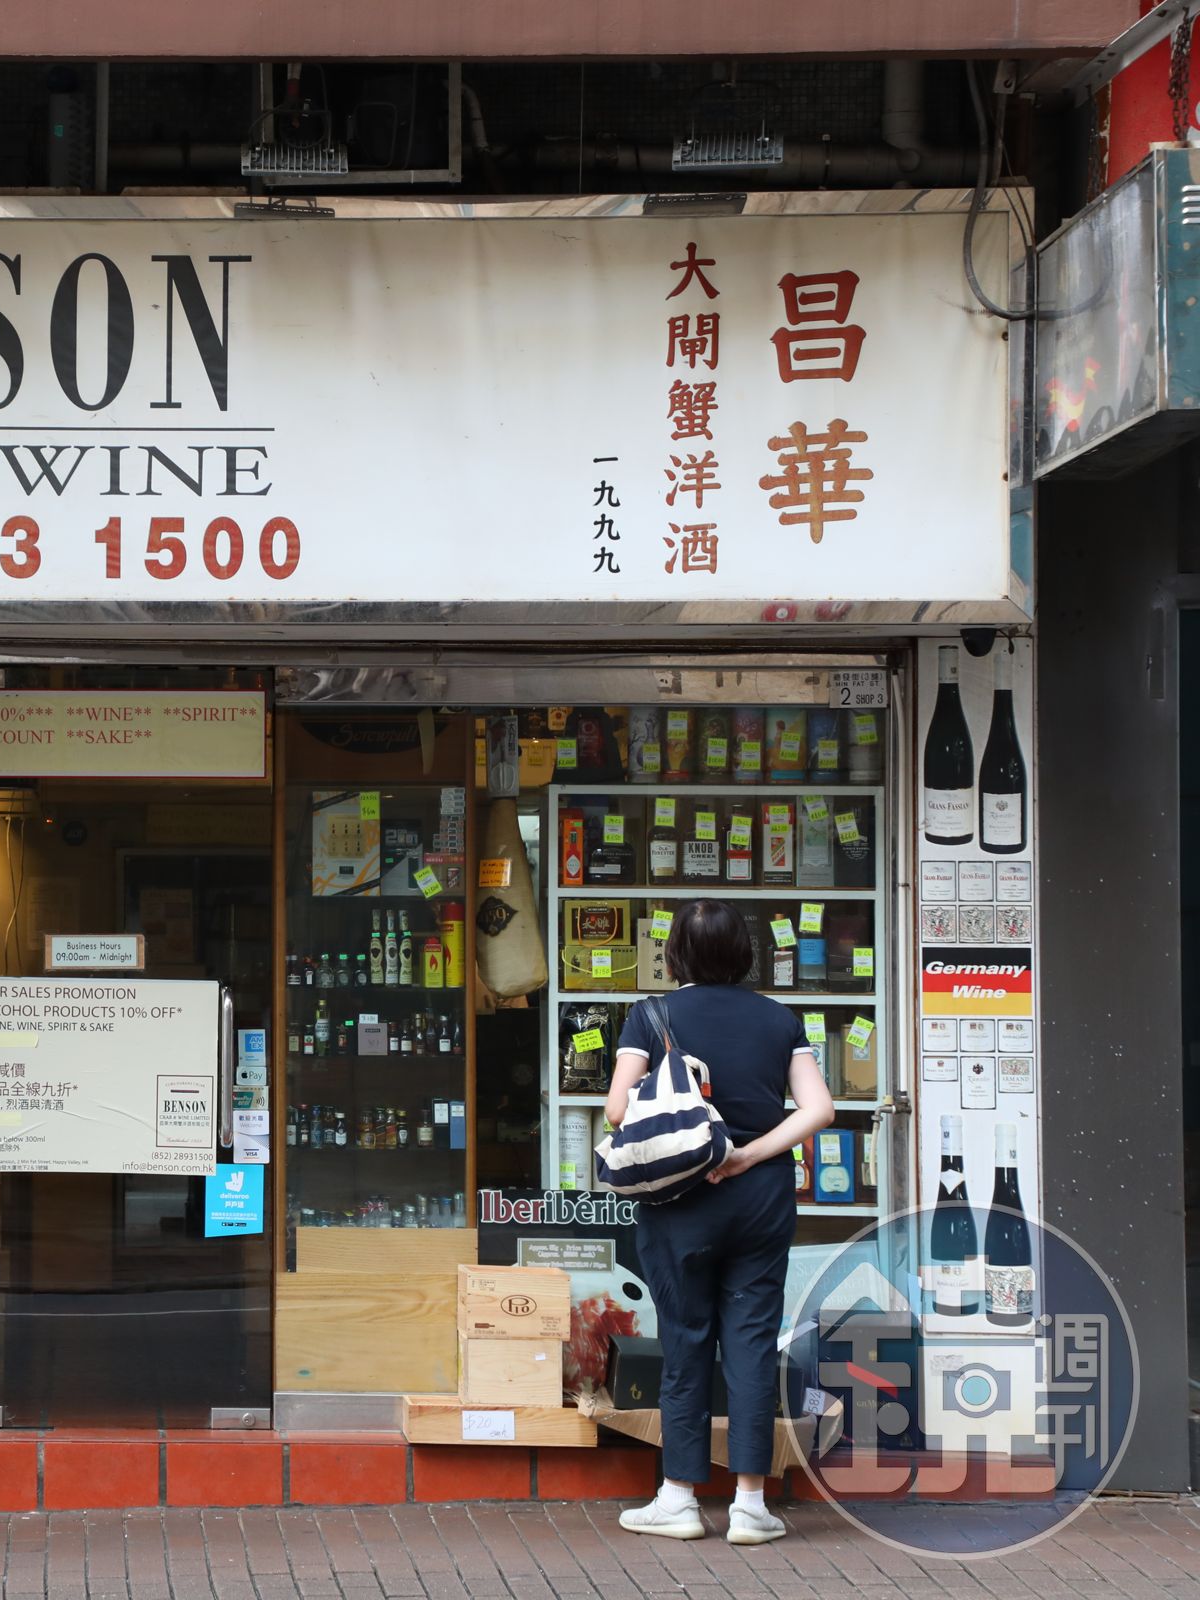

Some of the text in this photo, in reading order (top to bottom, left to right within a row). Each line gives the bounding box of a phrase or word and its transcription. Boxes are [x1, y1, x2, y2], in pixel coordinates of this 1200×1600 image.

[664, 241, 721, 575] 大閘蟹洋酒
[758, 269, 873, 544] 昌華
[592, 456, 620, 574] 一九九九
[95, 515, 301, 580] 1500
[841, 688, 884, 705] 2 SHOP 3
[688, 843, 713, 853] KNOB
[66, 941, 121, 951] Business Hours
[56, 952, 90, 962] 09:00am
[100, 952, 132, 963] Midnight
[925, 961, 1027, 978] Germany
[11, 986, 50, 998] SALES
[54, 987, 136, 1000] PROMOTION
[952, 985, 1007, 1000] Wine
[43, 1005, 116, 1018] PRODUCTS
[120, 1007, 147, 1018] 10%
[17, 1021, 45, 1032] WINE,
[47, 1022, 77, 1032] SPIRIT
[79, 1022, 87, 1032] &
[89, 1022, 115, 1032] SAKE
[249, 1071, 263, 1081] Pay
[6, 1099, 64, 1111] 烈酒與清酒
[163, 1100, 207, 1113] BENSON
[151, 1152, 214, 1161] (852) 28931500
[122, 1162, 213, 1173] info@benson.com.hk
